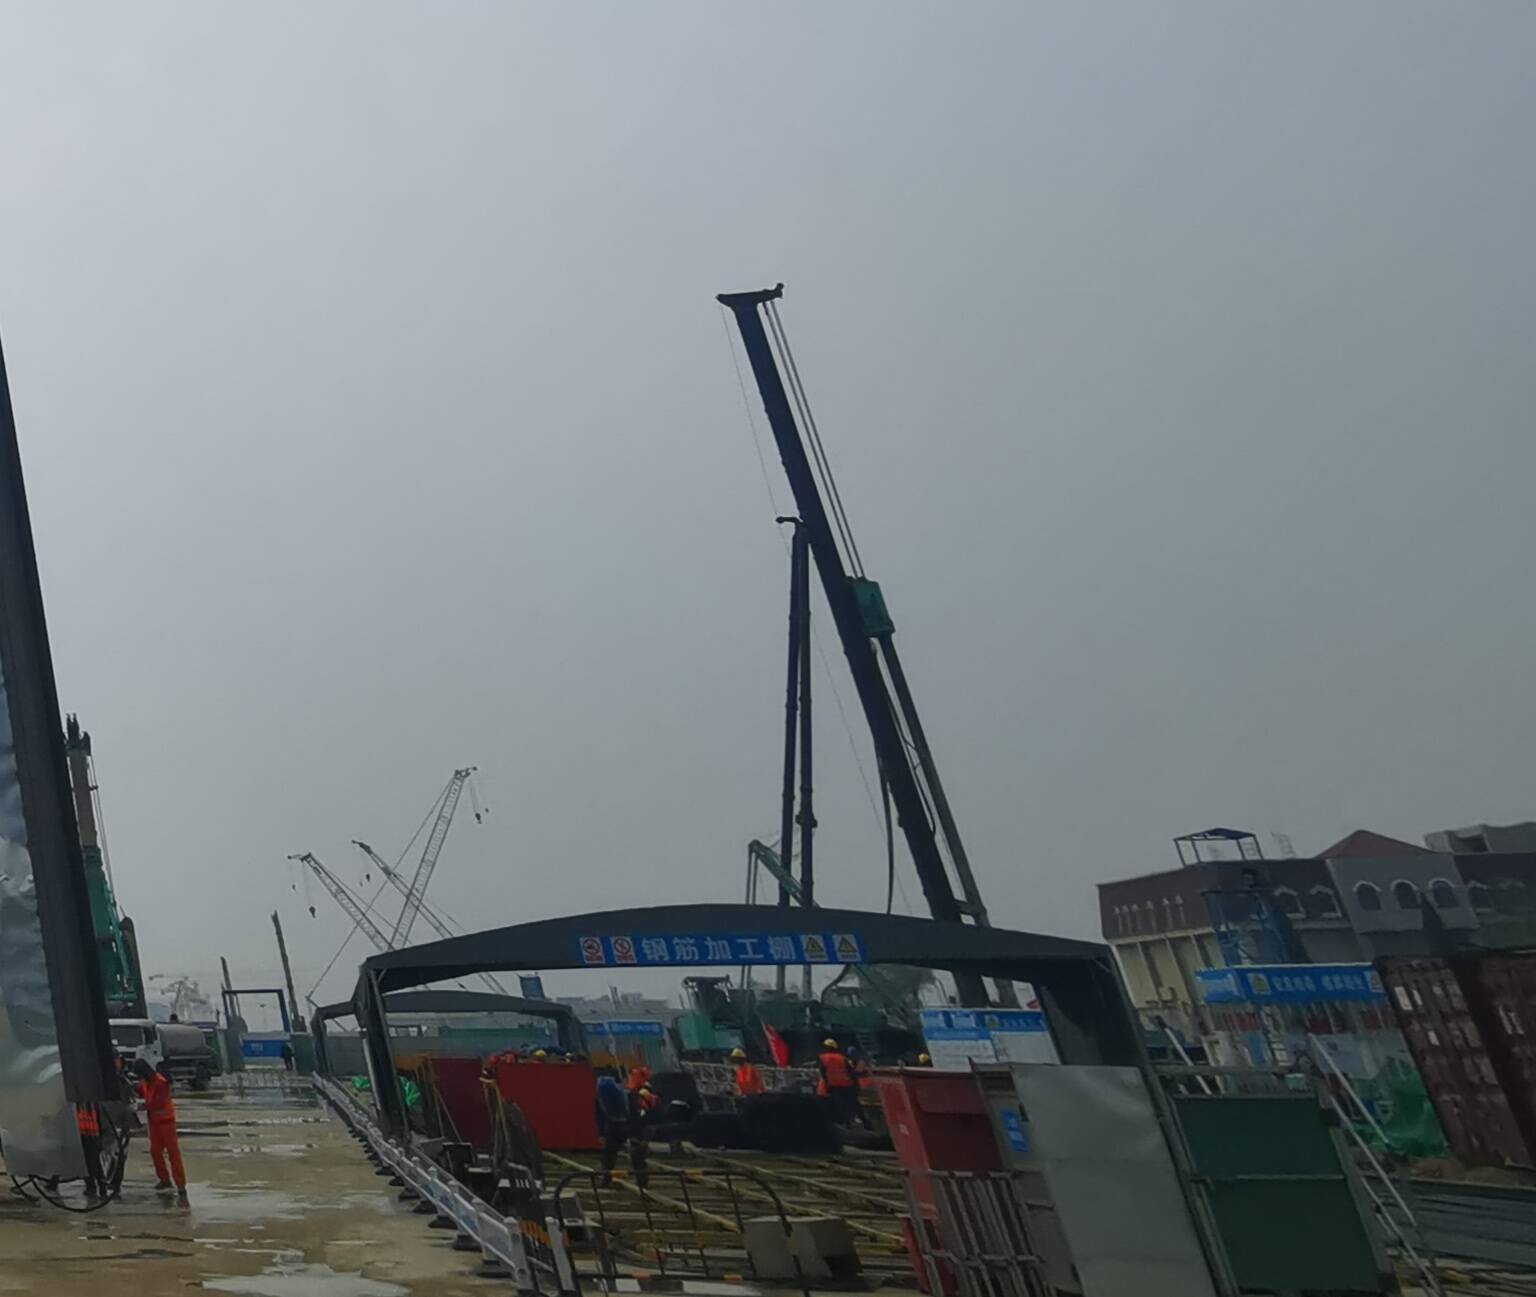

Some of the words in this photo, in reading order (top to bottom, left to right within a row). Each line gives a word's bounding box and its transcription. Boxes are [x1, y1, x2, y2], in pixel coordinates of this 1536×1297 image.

[641, 936, 797, 962] 钢筋加工棚
